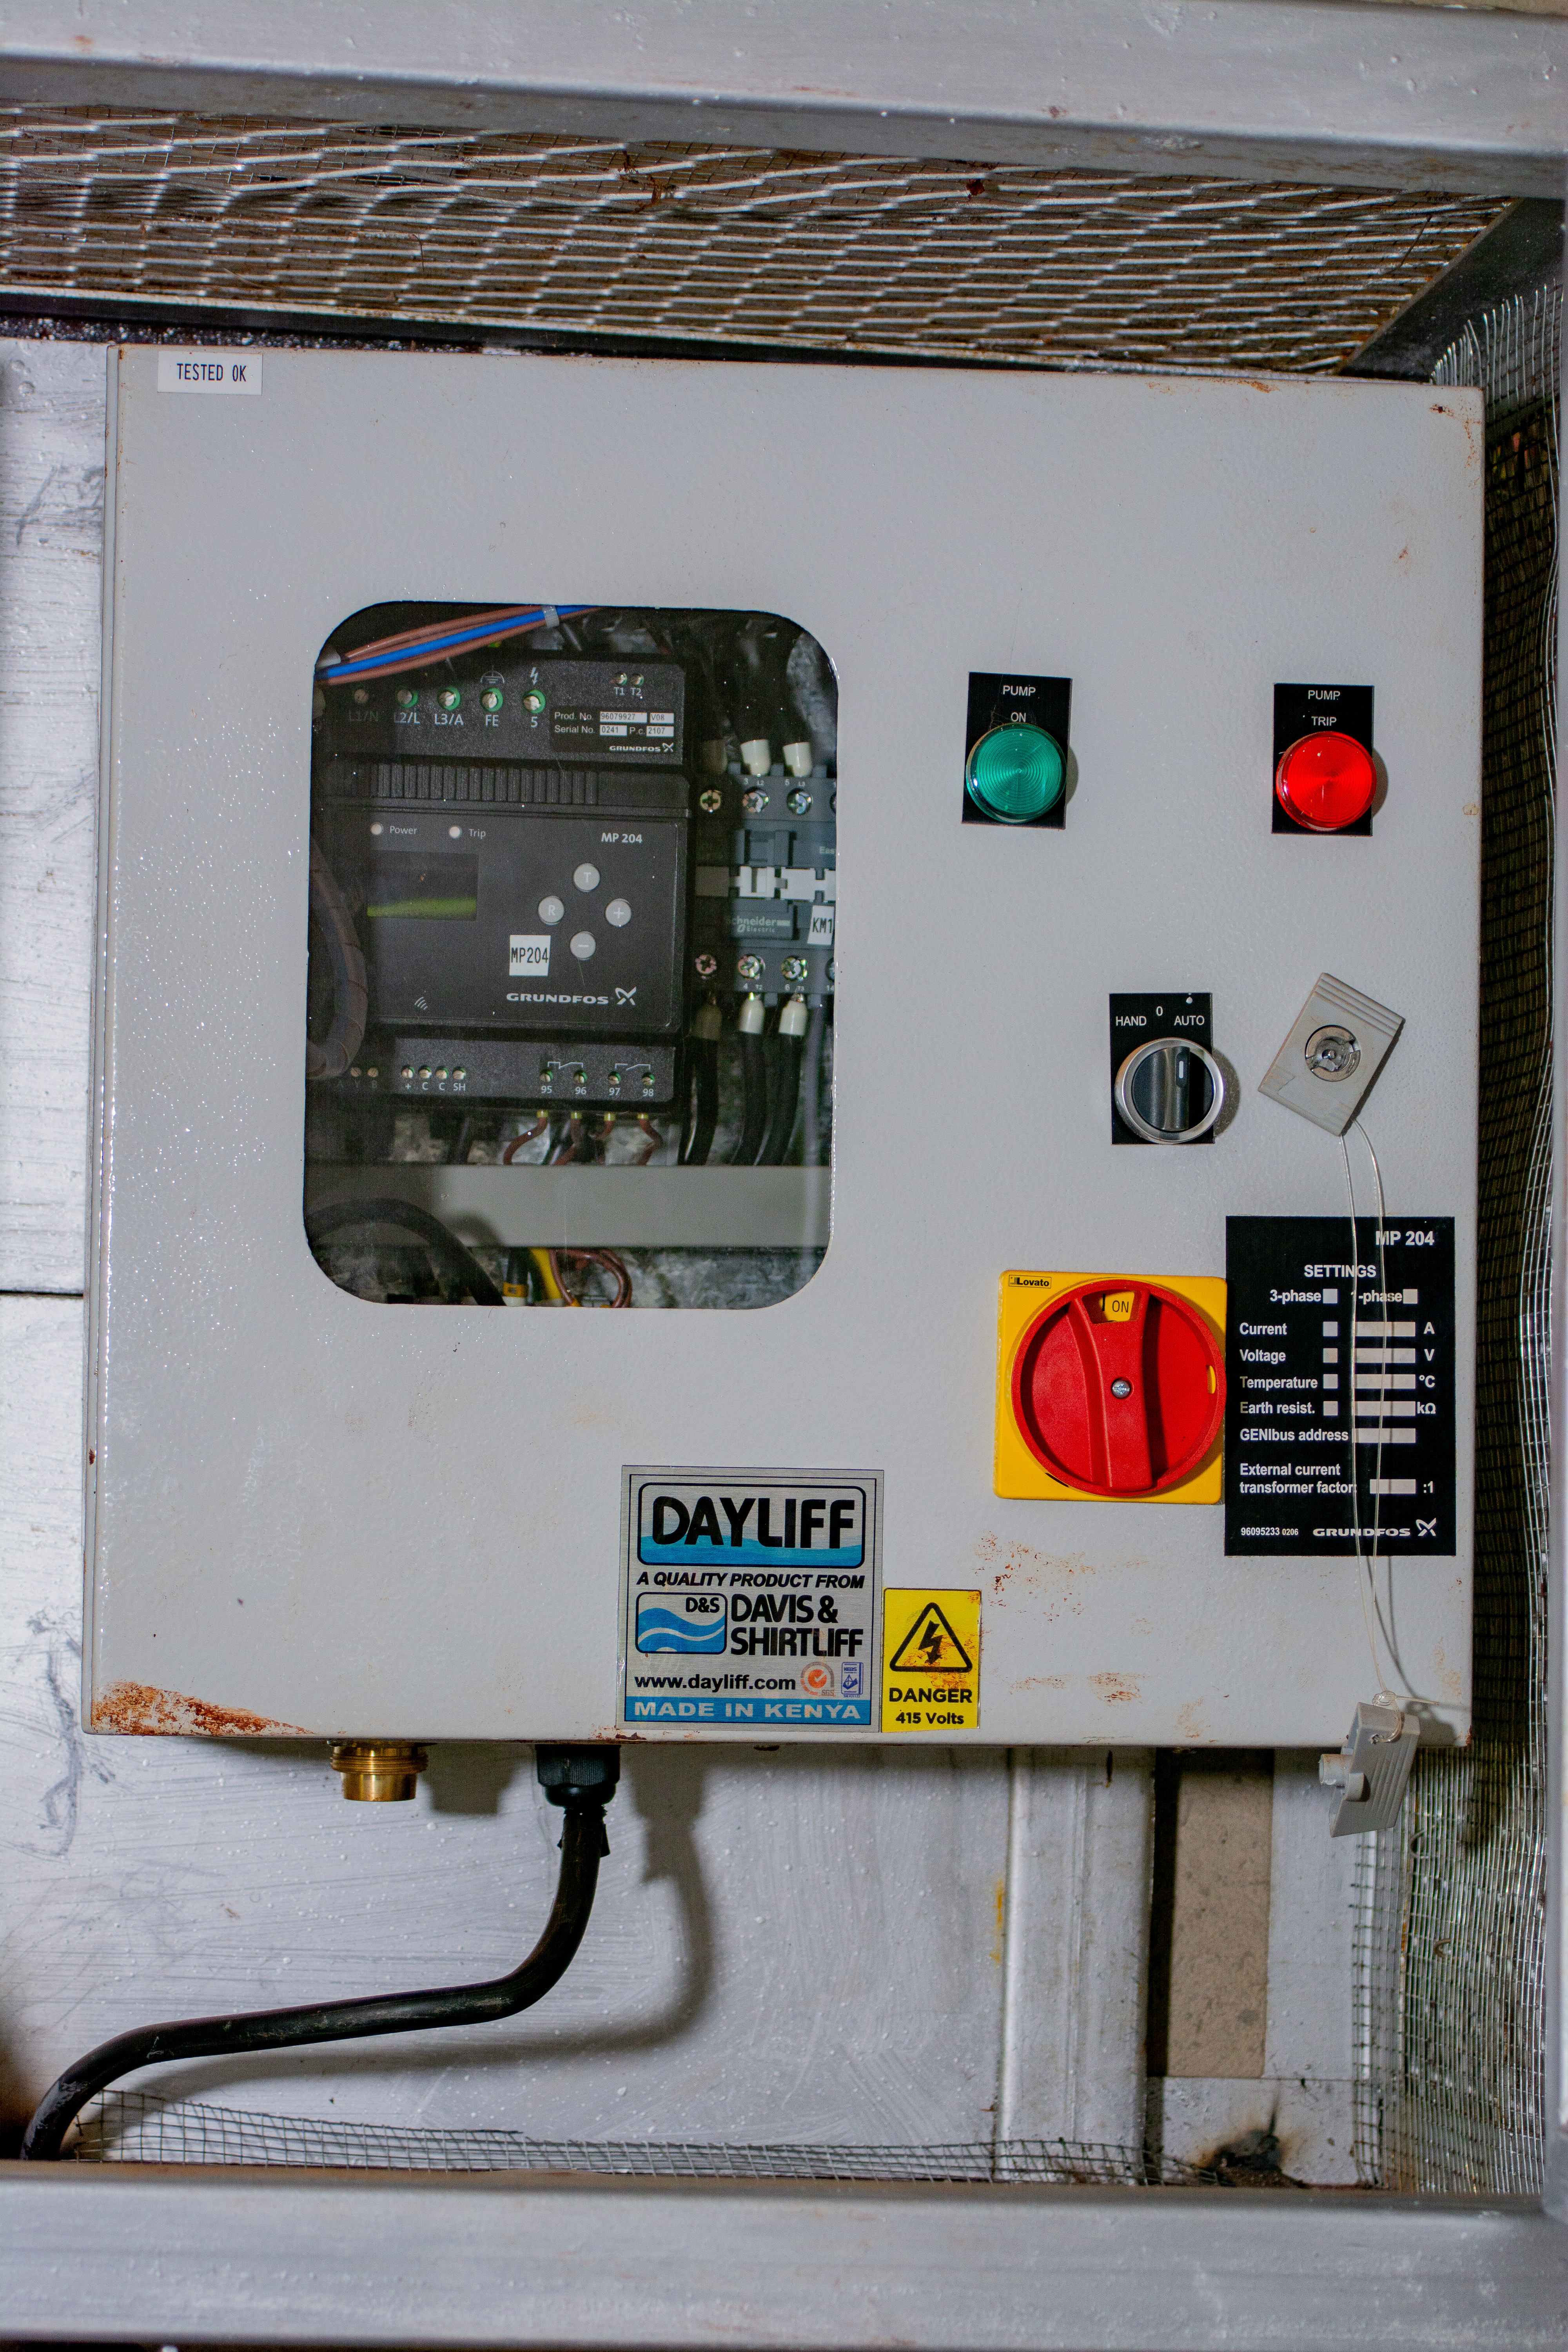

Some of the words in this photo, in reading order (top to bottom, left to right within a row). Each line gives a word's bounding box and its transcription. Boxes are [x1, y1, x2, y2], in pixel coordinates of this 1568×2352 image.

[177, 363, 223, 381] TESTED
[232, 365, 247, 382] OK
[613, 687, 625, 696] T1
[630, 688, 641, 696] T2
[1003, 685, 1036, 696] PUMP
[1308, 690, 1340, 700] PUMP
[394, 712, 420, 724] L2/L
[434, 714, 463, 726] L3/A
[485, 715, 499, 726] FE
[555, 711, 576, 720] Prod.
[580, 712, 593, 720] No.
[1011, 712, 1026, 722] ON
[1311, 716, 1337, 726] TRIP
[531, 717, 537, 727] 5
[390, 826, 417, 835] Power
[469, 829, 486, 839] Trip
[601, 832, 619, 842] MP
[622, 833, 642, 844] 204
[584, 872, 591, 883] T
[548, 904, 556, 916] R
[724, 916, 777, 926] chneider
[812, 917, 833, 933] KM1
[511, 947, 548, 964] MP204
[506, 993, 609, 1004] GRUNDFOS
[1116, 1016, 1147, 1026] HAND
[1174, 1015, 1205, 1025] AUTO
[422, 1082, 428, 1091] C
[439, 1082, 445, 1091] C
[454, 1083, 466, 1091] SH
[541, 1085, 552, 1094] 95
[575, 1087, 587, 1095] 96
[609, 1087, 620, 1096] 97
[643, 1089, 654, 1097] 98
[1376, 1231, 1401, 1246] MP
[1405, 1231, 1434, 1246] 204
[1304, 1264, 1376, 1278] SETTINGS
[1017, 1277, 1049, 1287] Lovato
[1270, 1289, 1321, 1304] 3-phase
[1112, 1300, 1129, 1312] ON
[1240, 1323, 1287, 1335] Current
[1423, 1322, 1435, 1334] A
[1240, 1349, 1286, 1364] Voltage
[1424, 1349, 1435, 1361] V
[1240, 1376, 1318, 1391] Temperature
[1419, 1375, 1435, 1388] °C
[1240, 1401, 1273, 1414] Earth
[1277, 1401, 1315, 1414] resist.
[1417, 1402, 1436, 1414] kΩ
[1240, 1428, 1295, 1441] GENIbus
[1299, 1428, 1348, 1441] address
[1240, 1463, 1292, 1475] External
[1295, 1465, 1340, 1475] current
[1240, 1481, 1314, 1493] transformer
[1423, 1481, 1434, 1493] :1
[652, 1496, 855, 1549] DAYLIFF
[1241, 1527, 1280, 1535] 96095233
[636, 1572, 649, 1585] A
[654, 1572, 728, 1587] QUALITY
[730, 1573, 814, 1588] PRODUCT
[815, 1575, 865, 1589] FROM
[685, 1597, 720, 1613] D&S
[731, 1593, 814, 1623] DAVIS
[818, 1595, 838, 1624] &
[731, 1627, 864, 1657] SHIRTLIFF
[635, 1674, 796, 1693] www.dayliff.com
[889, 1687, 973, 1703] DANGER
[634, 1702, 715, 1717] MADE
[726, 1703, 753, 1717] IN
[765, 1703, 861, 1719] KENYA
[896, 1712, 921, 1724] 415
[926, 1711, 964, 1724] Volts
